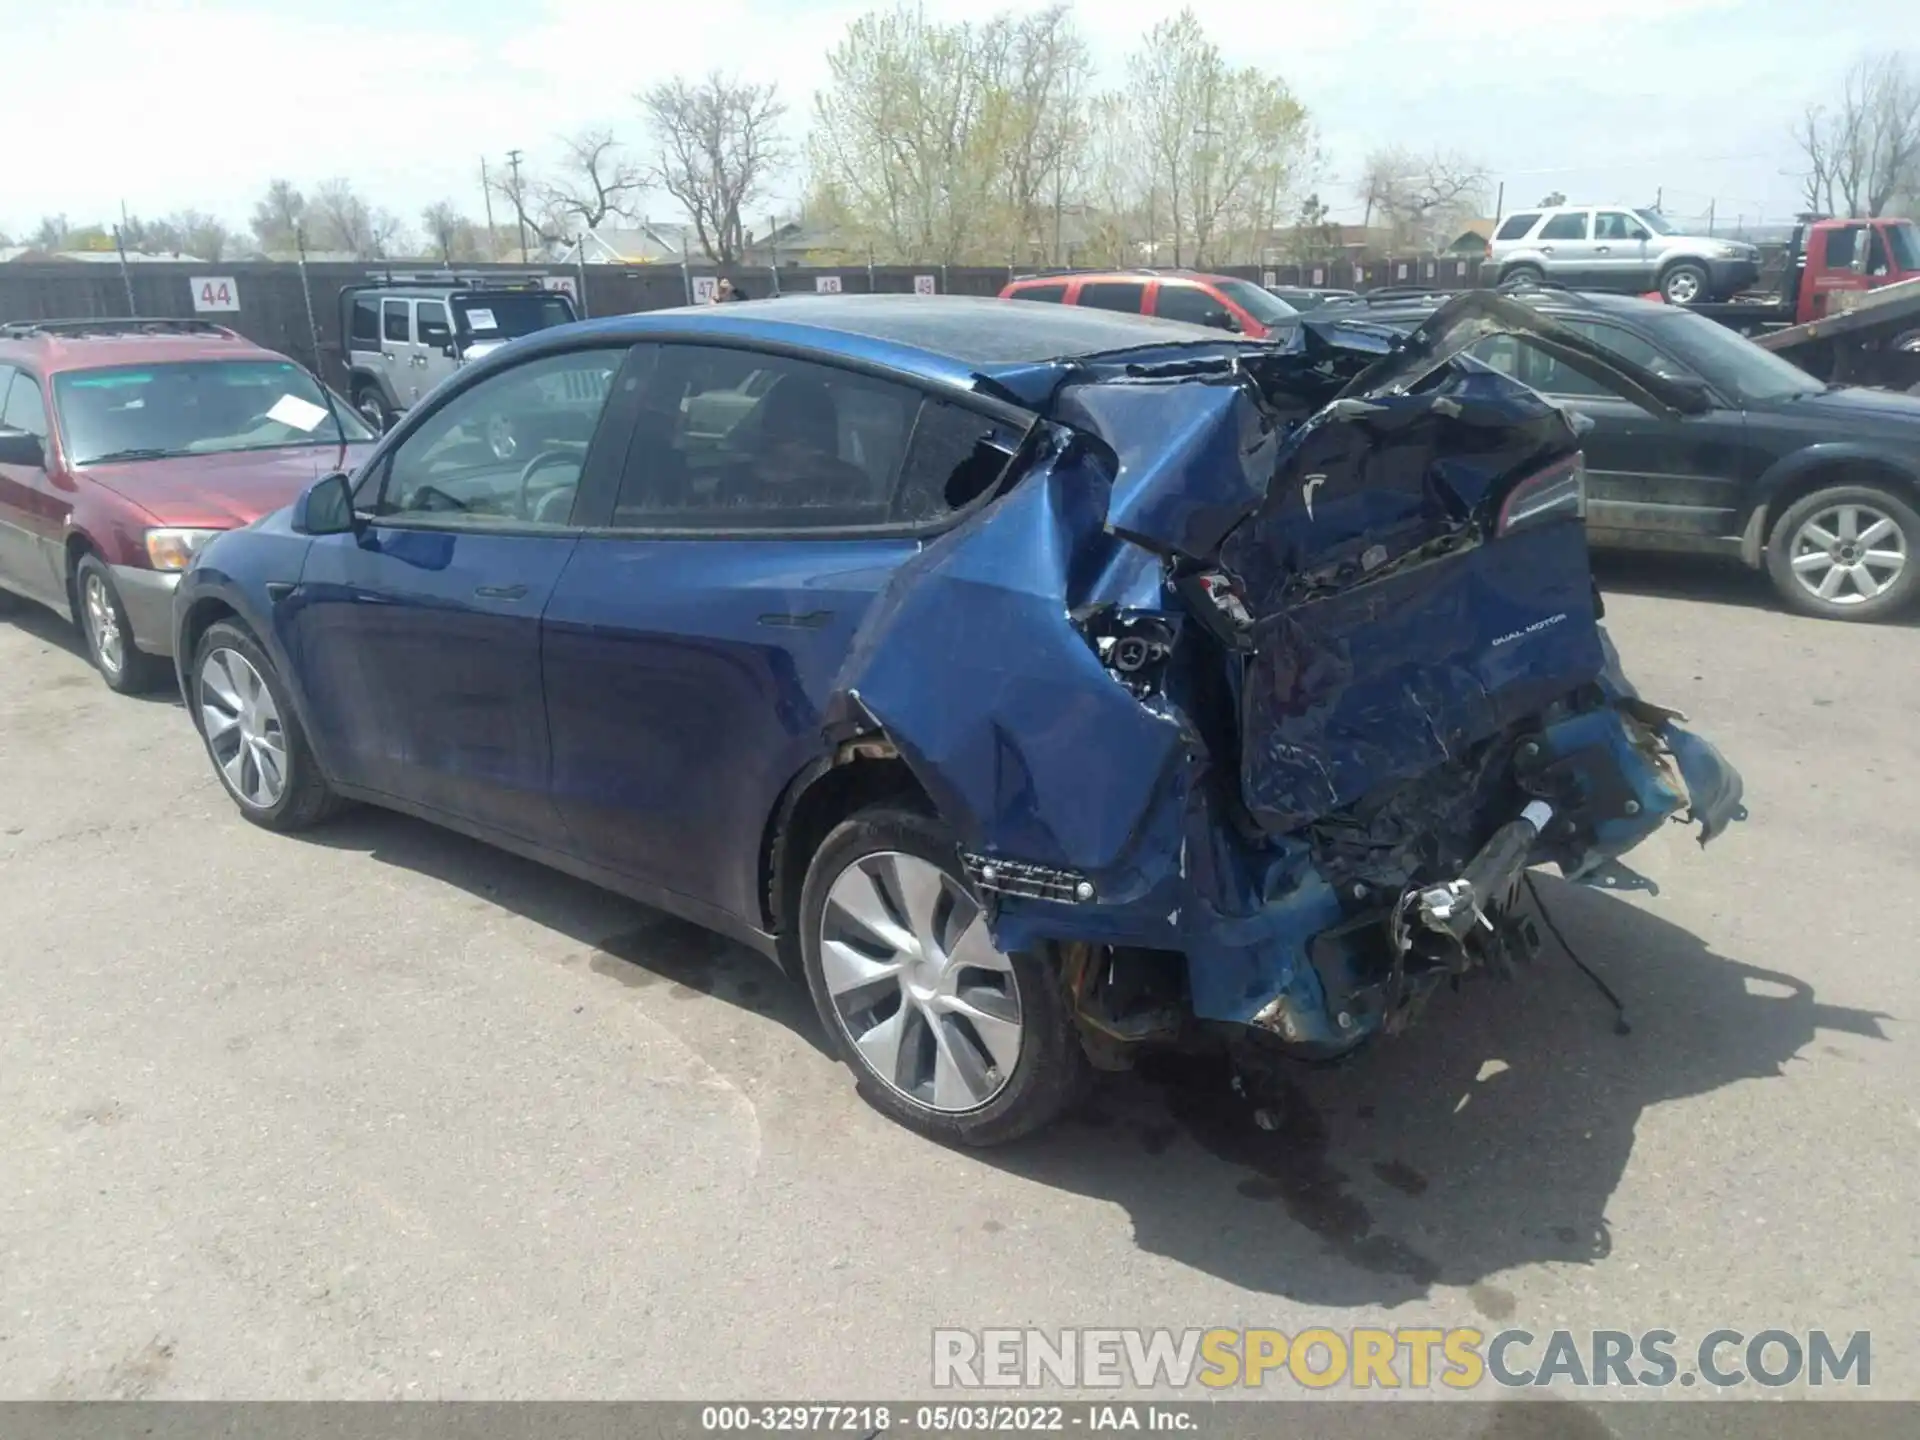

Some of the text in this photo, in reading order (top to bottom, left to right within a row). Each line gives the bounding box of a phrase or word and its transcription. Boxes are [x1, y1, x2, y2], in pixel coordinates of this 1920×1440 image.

[201, 282, 231, 306] 44
[698, 281, 715, 298] 47
[1492, 613, 1567, 646] DUAL MOTOR
